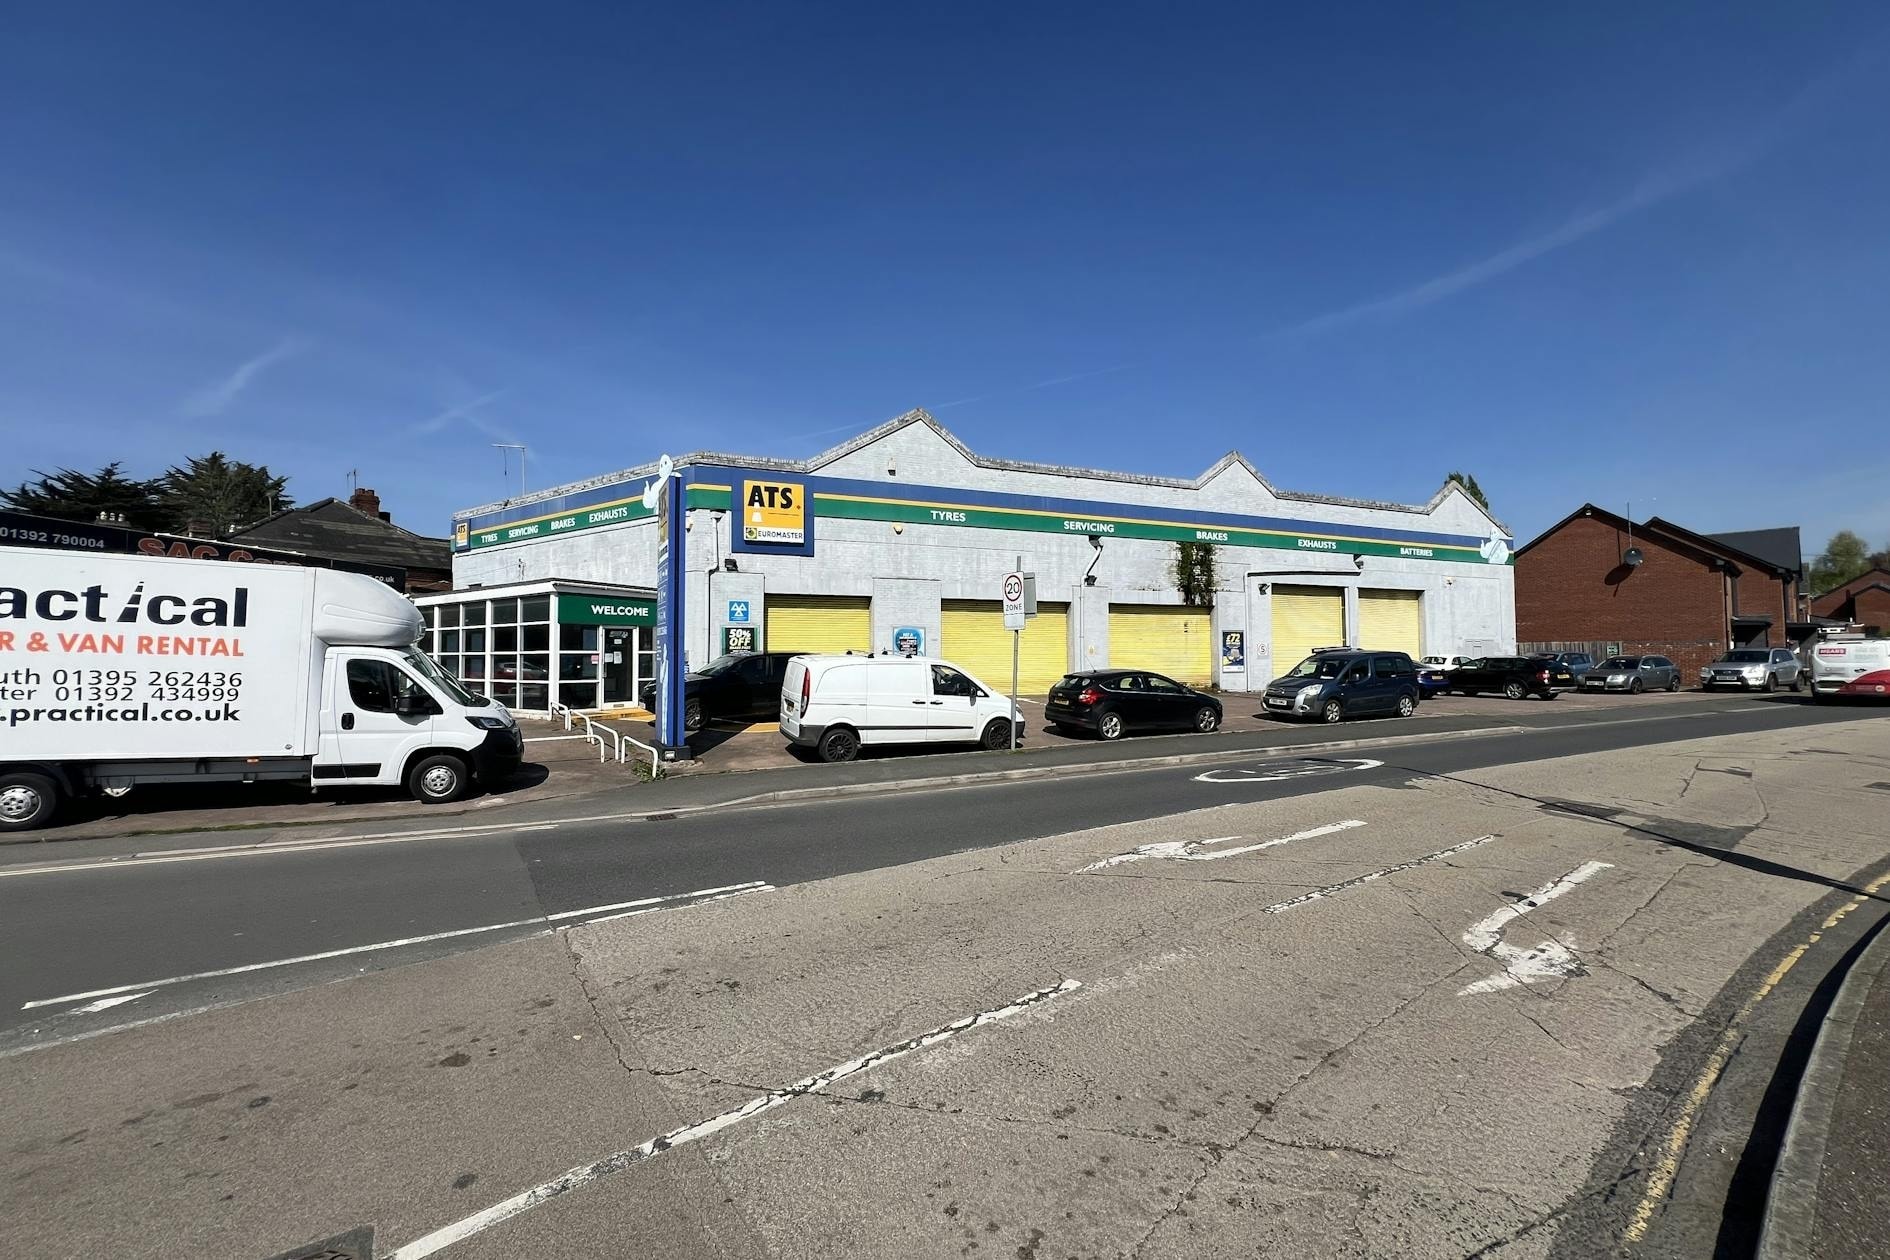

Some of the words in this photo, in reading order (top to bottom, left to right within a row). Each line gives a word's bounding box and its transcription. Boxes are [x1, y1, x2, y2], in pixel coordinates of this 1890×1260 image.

[748, 485, 793, 509] ATS
[481, 533, 498, 543] TYRES
[508, 525, 539, 538] SERVICING
[550, 517, 576, 530] BRAKES
[589, 507, 628, 523] EXHAUSTS
[0, 527, 48, 543] 01392
[53, 533, 105, 549] 790004
[758, 530, 803, 540] EUROMASTER
[930, 510, 967, 522] TYRES
[1063, 520, 1115, 534] SERVICING
[1196, 530, 1229, 541] BRAKES
[1298, 538, 1337, 550] EXHAUSTS
[1400, 547, 1434, 557] BATTERIES
[1006, 582, 1020, 595] 20
[591, 604, 649, 617] WELCOME
[1005, 603, 1022, 612] ZONE
[729, 628, 752, 638] 50%
[26, 631, 49, 652] &
[57, 633, 124, 654] VAN
[137, 635, 244, 657] RENTAL
[729, 637, 752, 647] OFF
[53, 669, 137, 685] 01395
[148, 671, 243, 687] 262436
[55, 687, 134, 701] 01392
[151, 687, 239, 702] 434999
